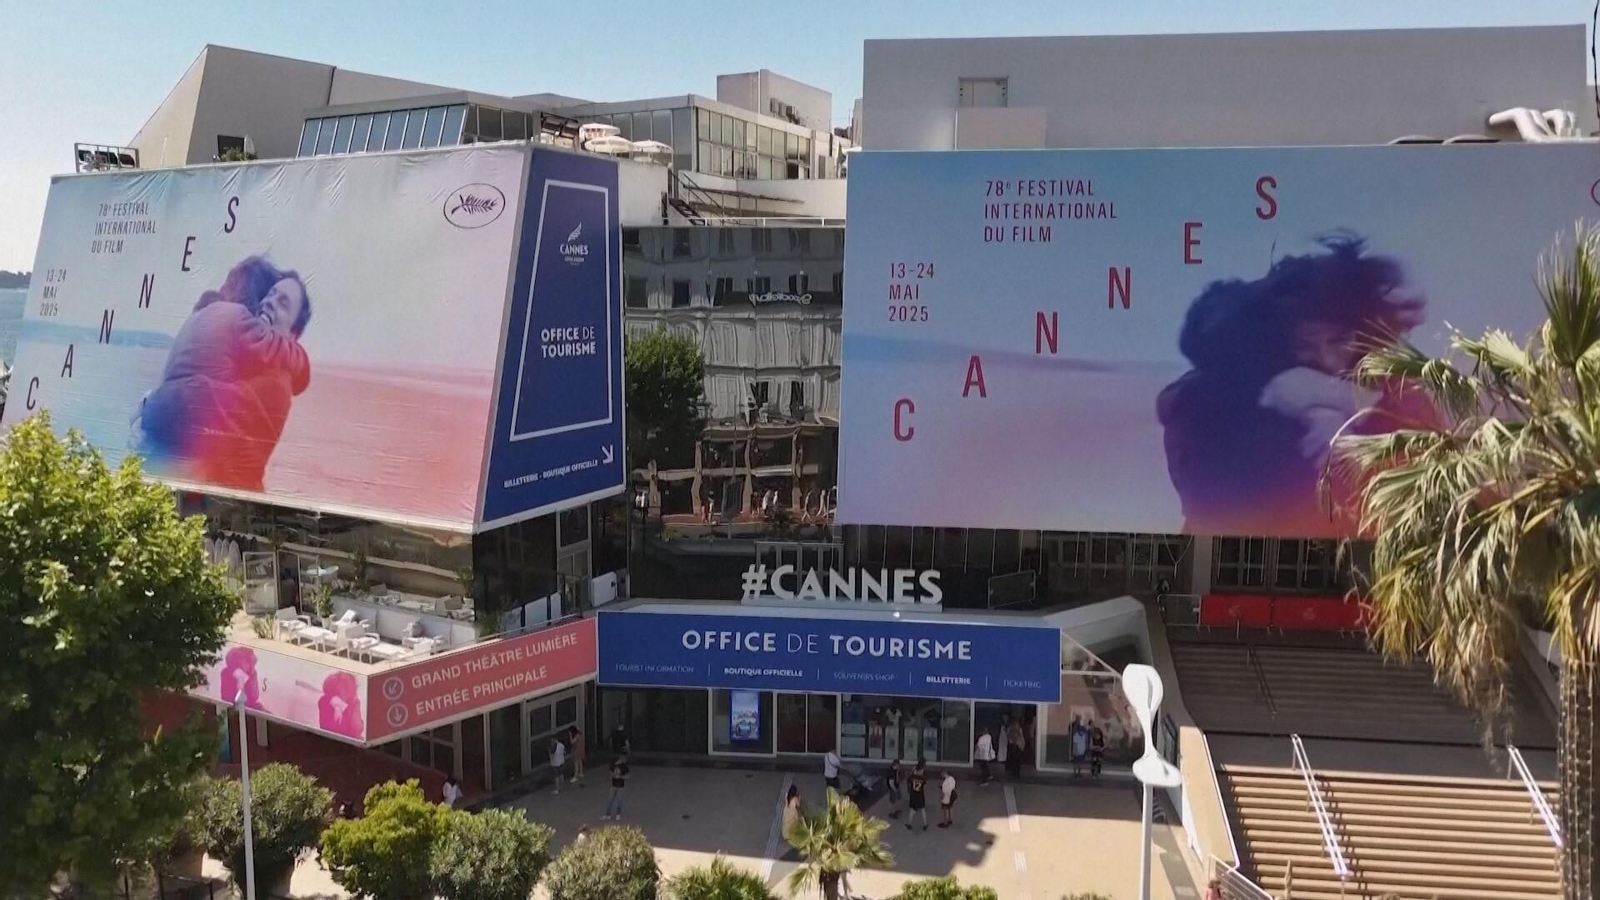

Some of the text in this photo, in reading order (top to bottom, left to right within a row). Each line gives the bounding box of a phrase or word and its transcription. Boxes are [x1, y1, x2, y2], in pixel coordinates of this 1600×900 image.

[1018, 180, 1094, 196] FESTIVAL
[113, 201, 149, 216] FESTIVAL
[984, 202, 1118, 219] INTERNATIONAL
[95, 220, 156, 235] INTERNATIONAL
[984, 226, 1051, 242] DU FILM
[91, 240, 123, 253] DU FILM
[560, 243, 589, 255] CANNES
[46, 269, 67, 282] 13-24
[891, 262, 934, 279] 13-24
[43, 286, 57, 299] MAI
[889, 284, 919, 300] MAI
[40, 303, 58, 317] 2025
[889, 305, 928, 322] 2025
[541, 326, 596, 342] OFFICE DE
[541, 341, 597, 358] TOURISME
[504, 473, 539, 488] BILLETTERIE
[543, 465, 570, 479] BOUTIQUE
[571, 459, 598, 472] OFFICIELLE
[741, 563, 943, 605] #CANNES
[682, 630, 972, 661] OFFICE DE TOURISME
[411, 632, 578, 688] GRAND THÉÂTRE LUMIÈRE
[616, 663, 694, 674] TOURIST INFORMATION
[724, 667, 803, 678] BOUTIQUE OFFICIELLE
[262, 677, 268, 691] S
[926, 676, 971, 685] BILLETTERIE
[1003, 679, 1041, 689] TICKETING
[415, 666, 548, 716] ENTRÉE PRINCIPALE
